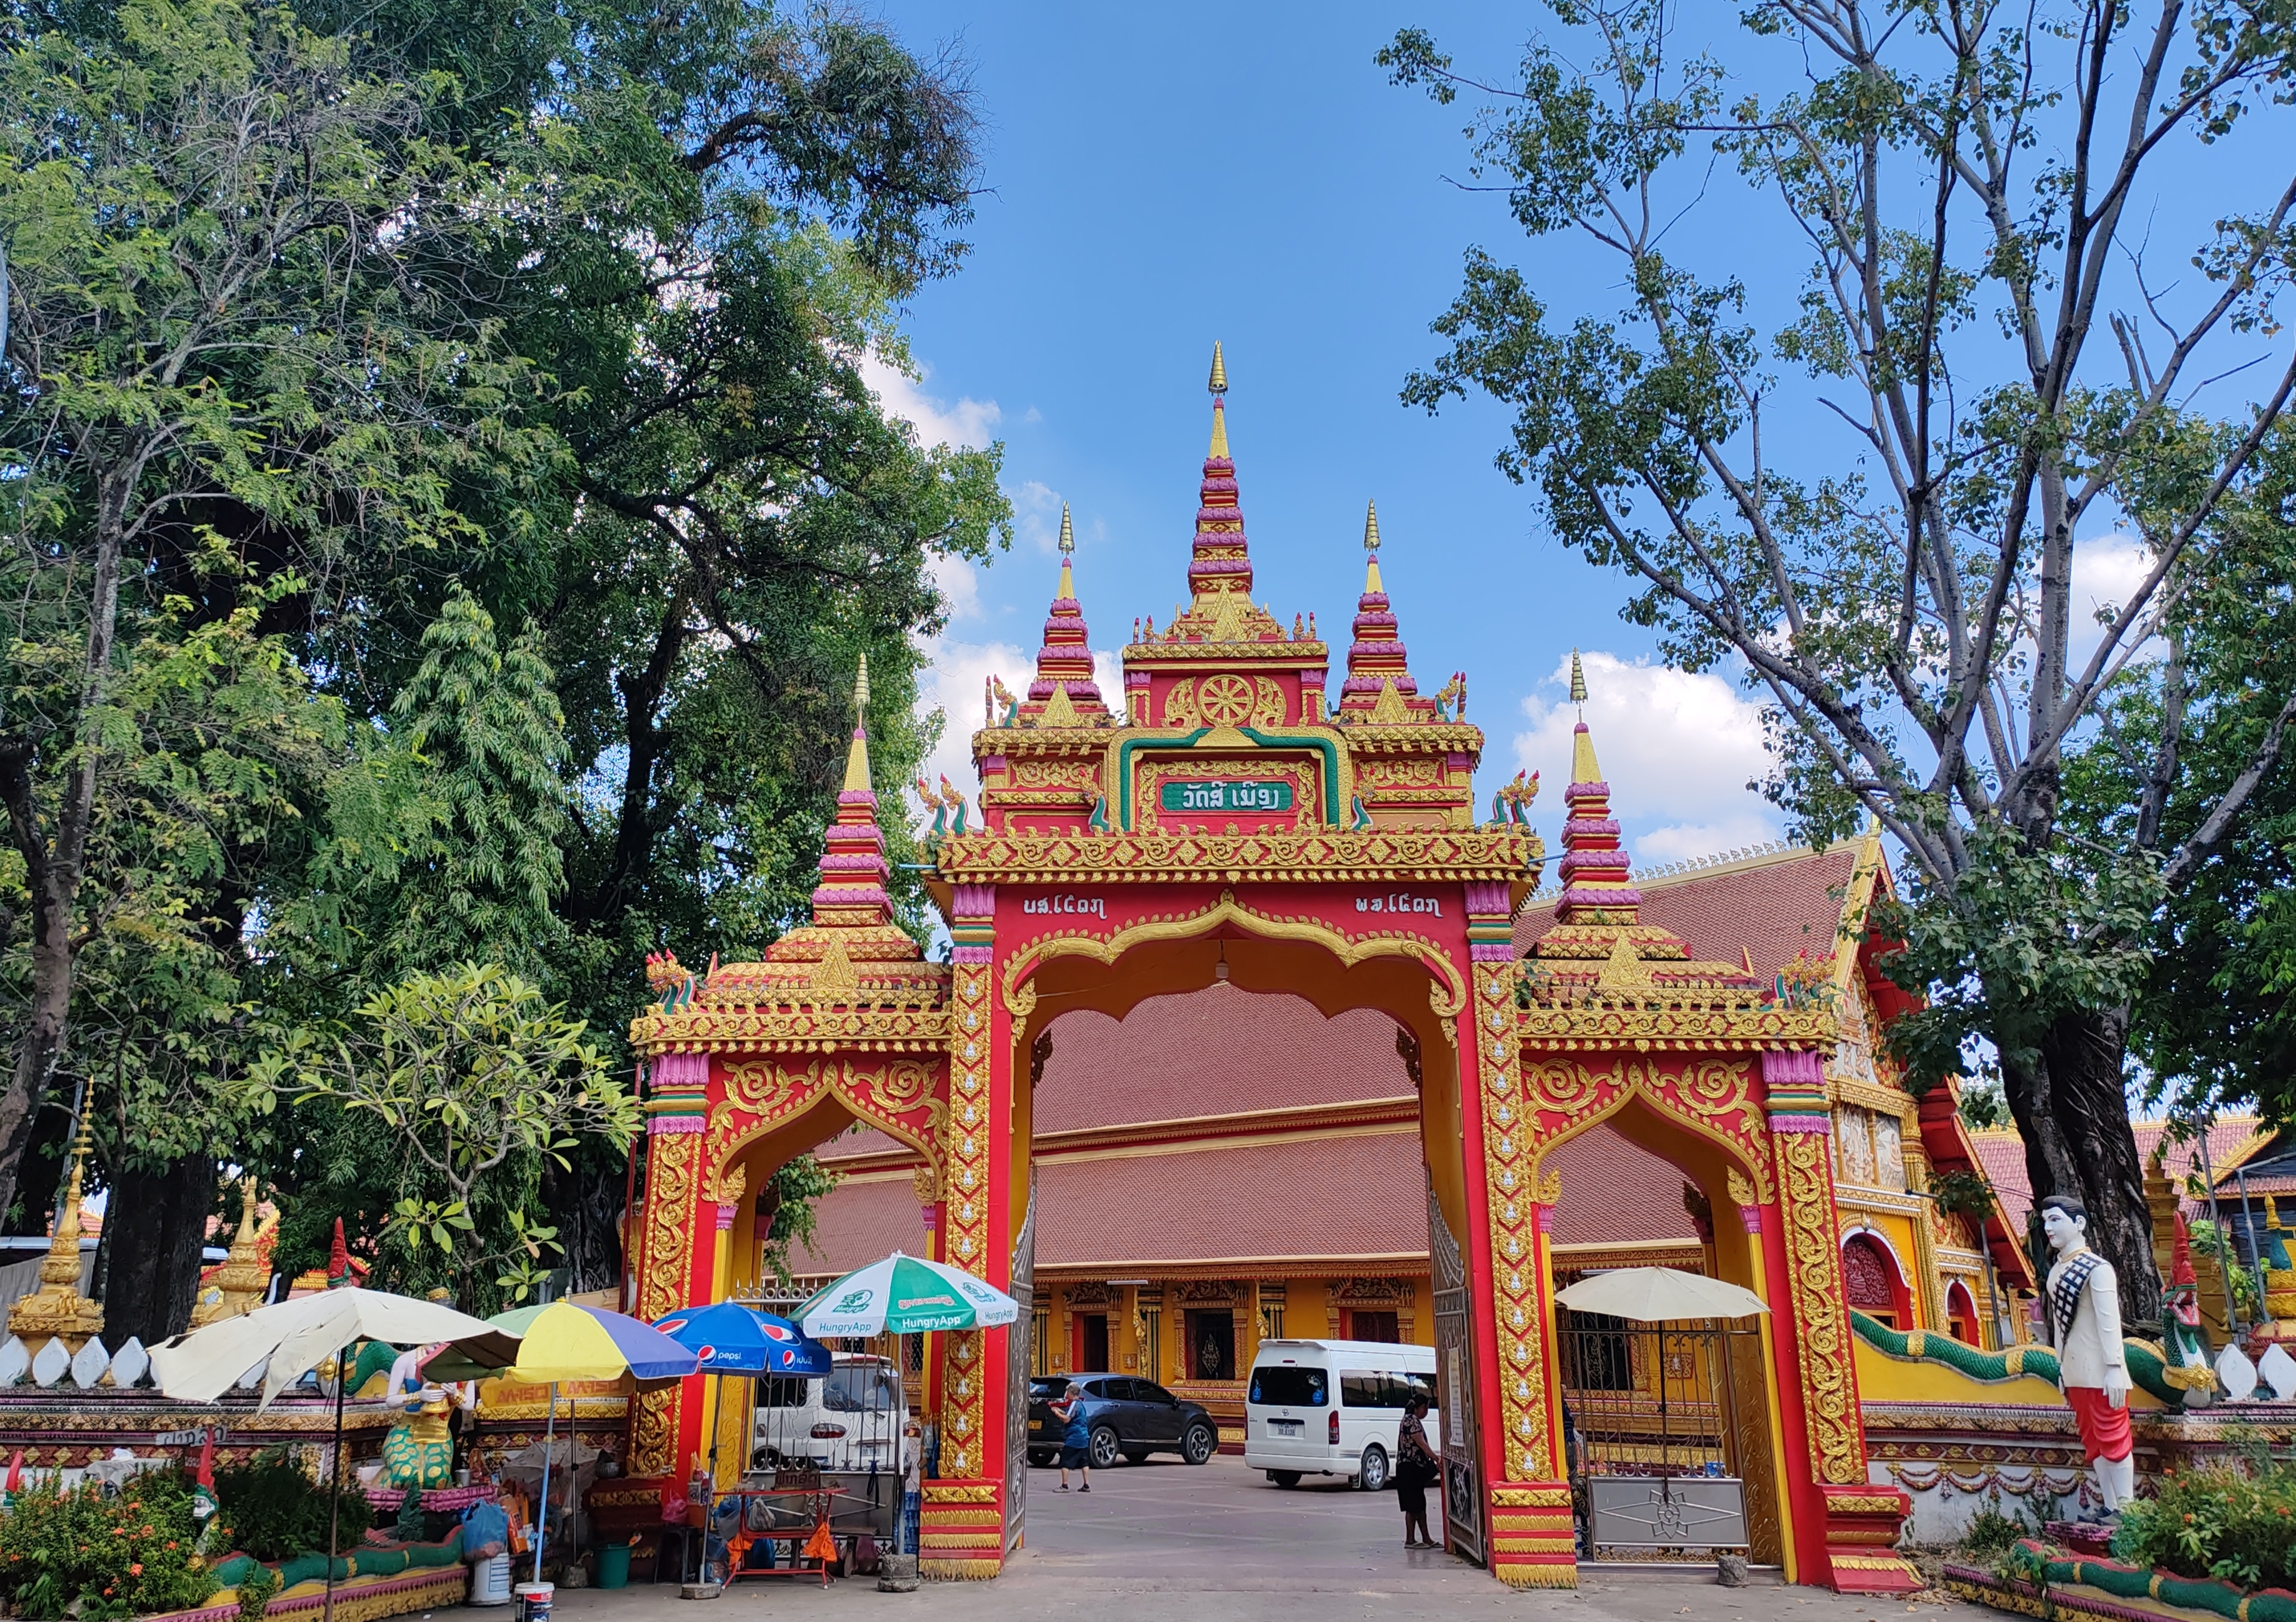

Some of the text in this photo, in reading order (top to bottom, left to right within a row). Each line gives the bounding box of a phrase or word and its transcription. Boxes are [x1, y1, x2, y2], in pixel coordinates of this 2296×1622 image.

[985, 1309, 1013, 1320] HungryApp
[819, 1322, 872, 1333] HungryApp
[902, 1315, 961, 1329] HungryApp
[718, 1351, 742, 1360] pepsi
